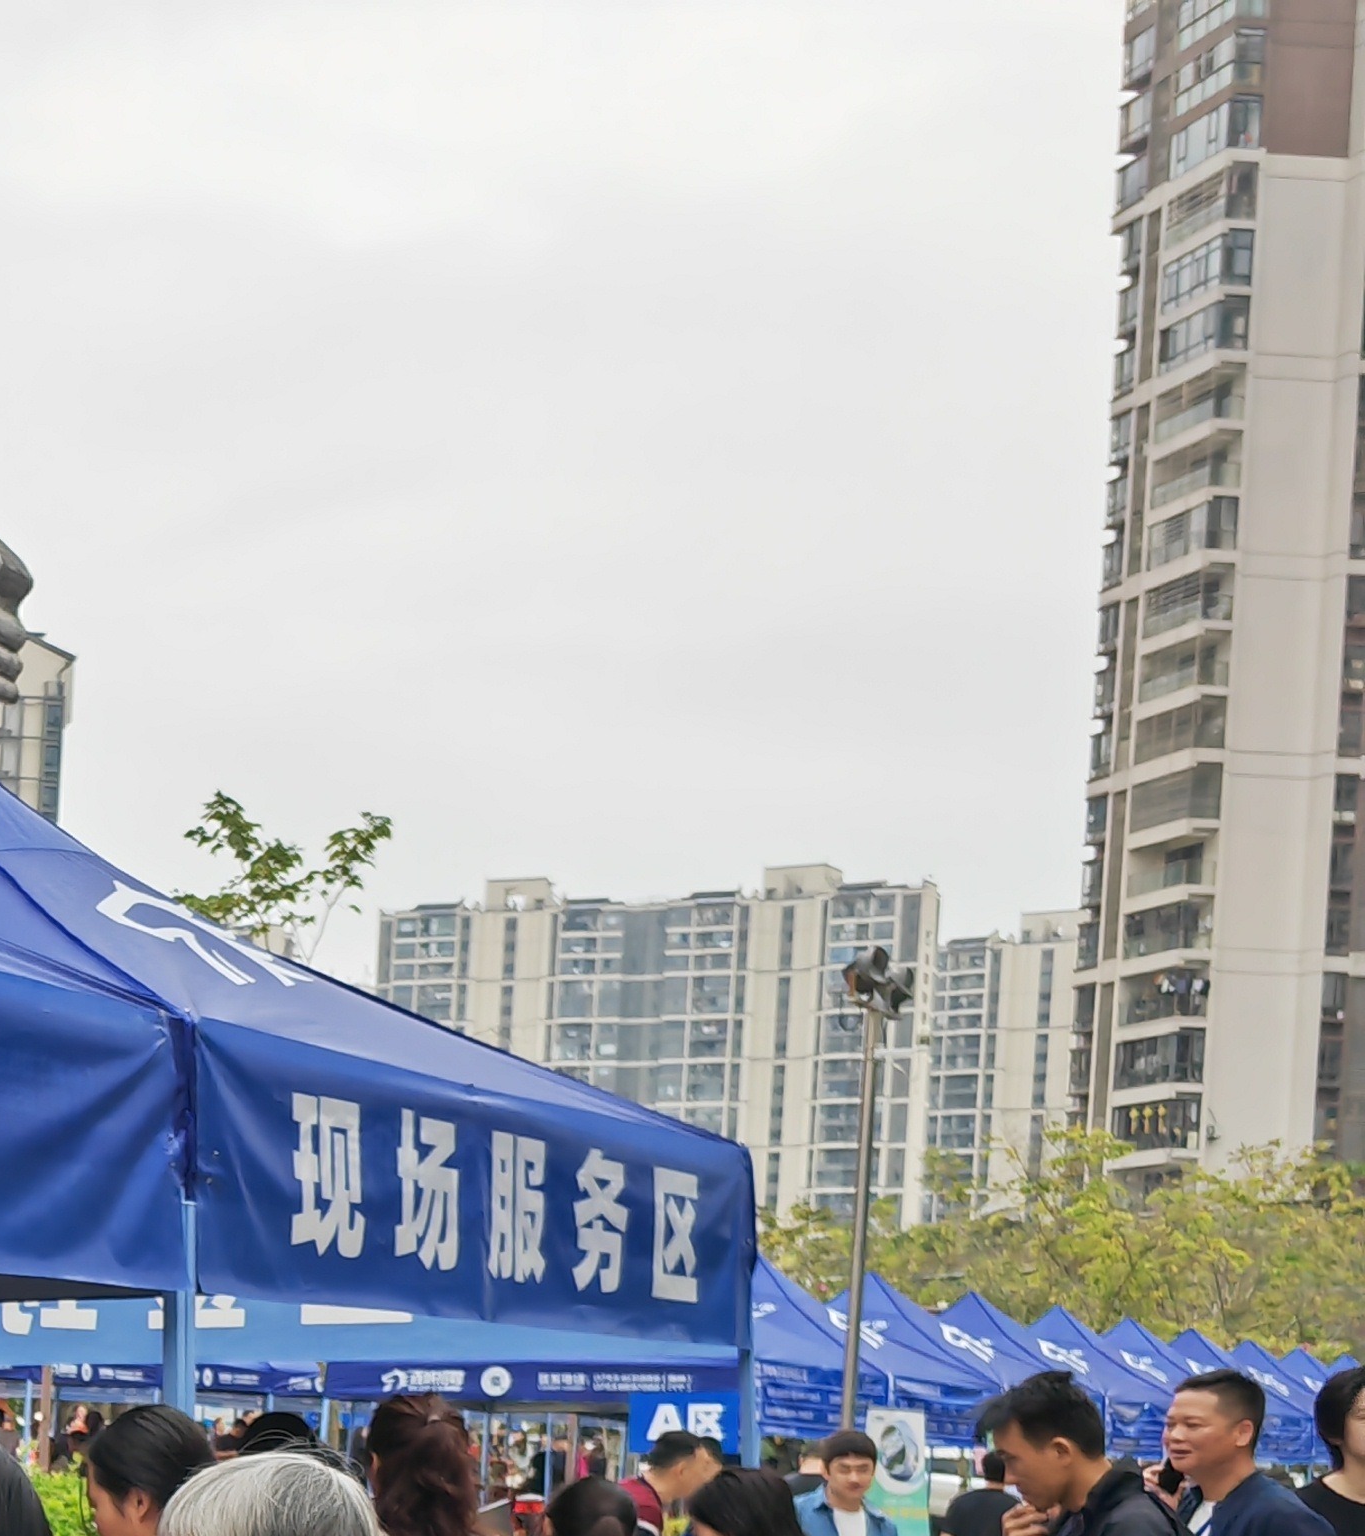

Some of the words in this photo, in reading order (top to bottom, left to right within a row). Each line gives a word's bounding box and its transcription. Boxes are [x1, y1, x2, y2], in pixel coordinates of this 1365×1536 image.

[290, 1091, 699, 1304] 现场服务区
[645, 1402, 725, 1442] A区
